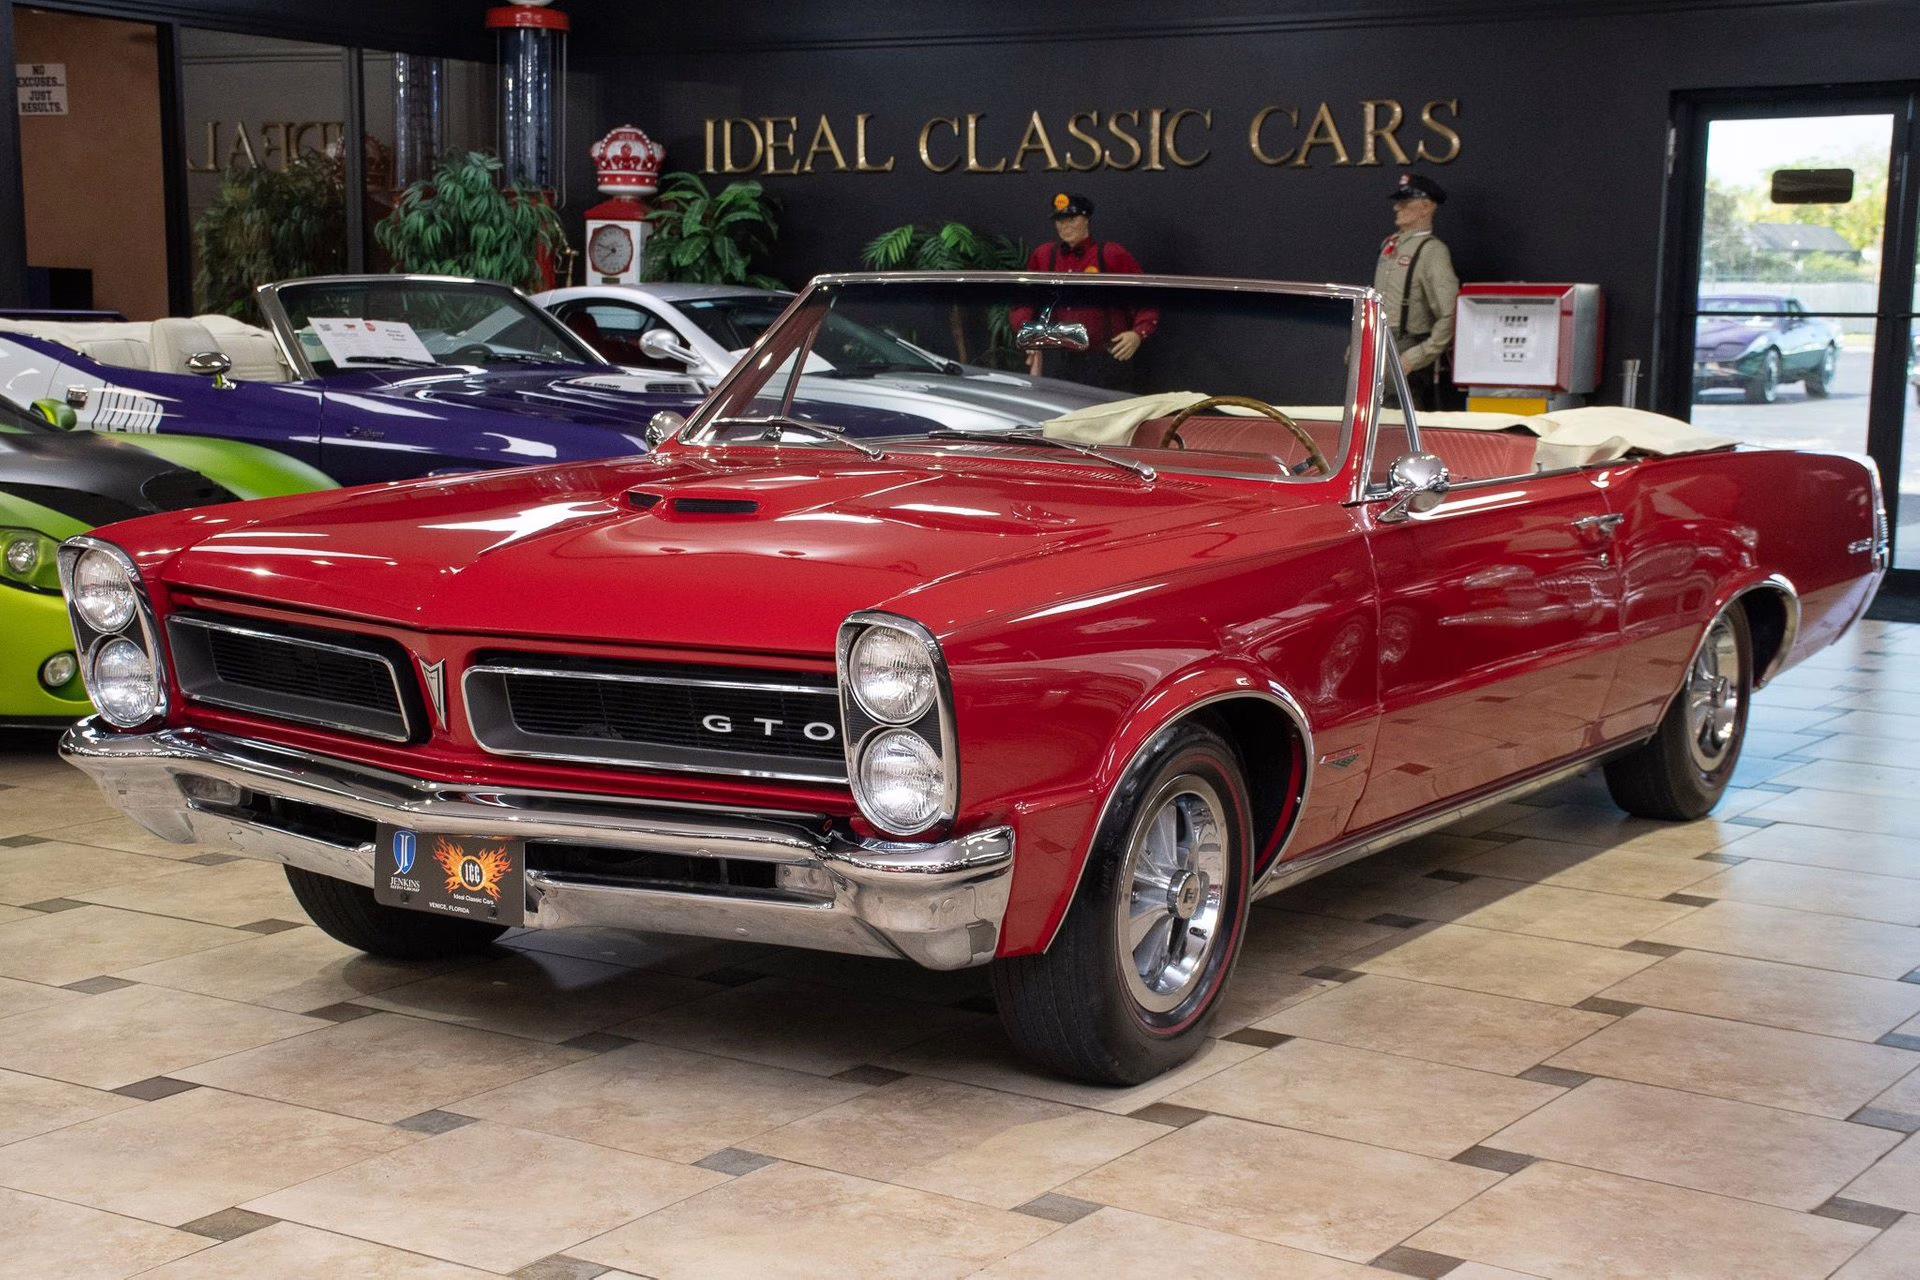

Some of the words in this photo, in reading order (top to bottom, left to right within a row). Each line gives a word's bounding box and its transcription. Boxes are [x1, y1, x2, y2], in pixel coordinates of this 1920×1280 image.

[32, 65, 45, 75] NO
[29, 90, 51, 101] JUST
[702, 113, 895, 175] IDEAL
[918, 109, 1212, 173] CLASSIC
[1250, 99, 1461, 168] CARS
[390, 876, 421, 887] JENKINS
[453, 893, 465, 901] Ideal
[465, 895, 482, 904] Classic
[482, 897, 494, 905] Cars
[448, 904, 470, 914] FLORIDA
